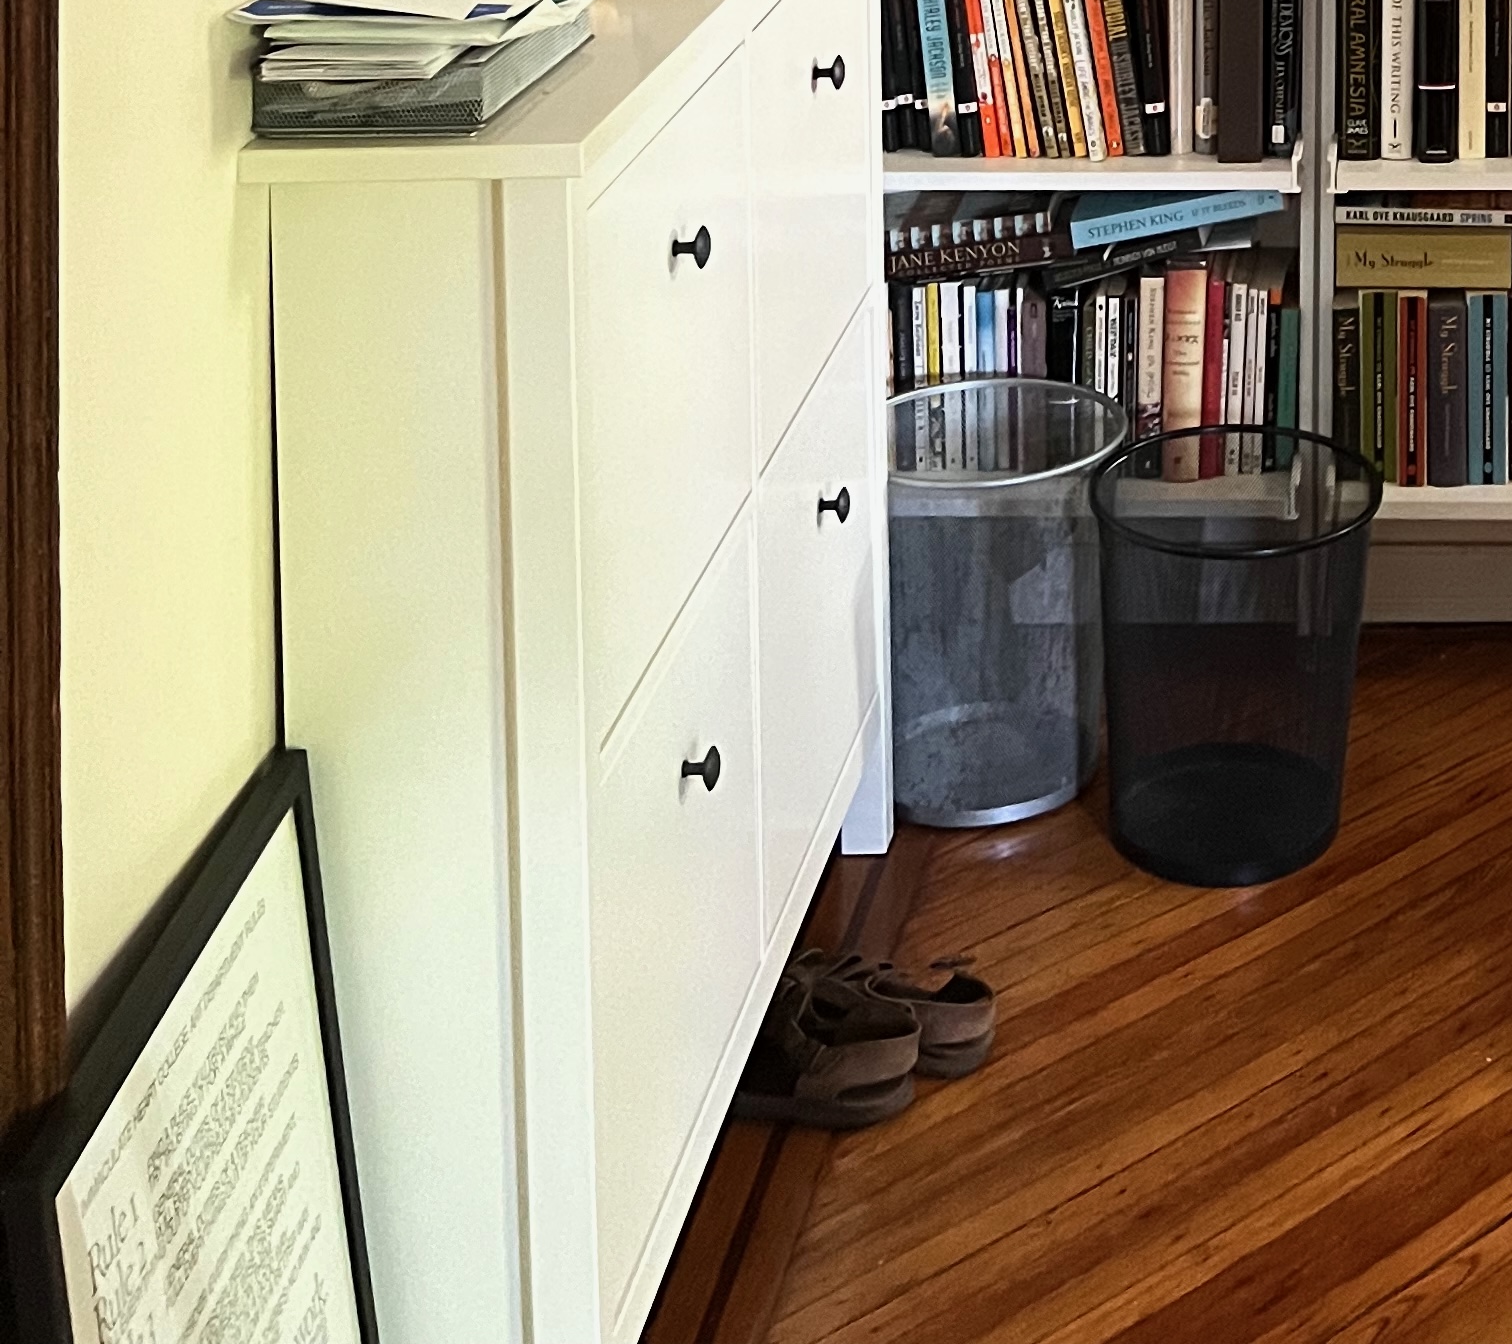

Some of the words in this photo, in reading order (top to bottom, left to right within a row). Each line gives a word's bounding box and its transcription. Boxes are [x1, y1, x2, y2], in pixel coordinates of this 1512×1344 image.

[1391, 13, 1402, 46] THIS
[1350, 19, 1366, 116] AMNESIA
[1390, 50, 1402, 115] WRITING
[1088, 218, 1146, 239] STEPHEN
[1150, 211, 1184, 226] KING
[1345, 210, 1370, 222] KARL
[1372, 211, 1390, 222] OVE
[1392, 211, 1454, 223] KNAUSGAARD
[890, 252, 934, 274] JANE
[940, 241, 1021, 266] KENYON
[1354, 250, 1376, 269] My
[1381, 252, 1434, 268] Struggle
